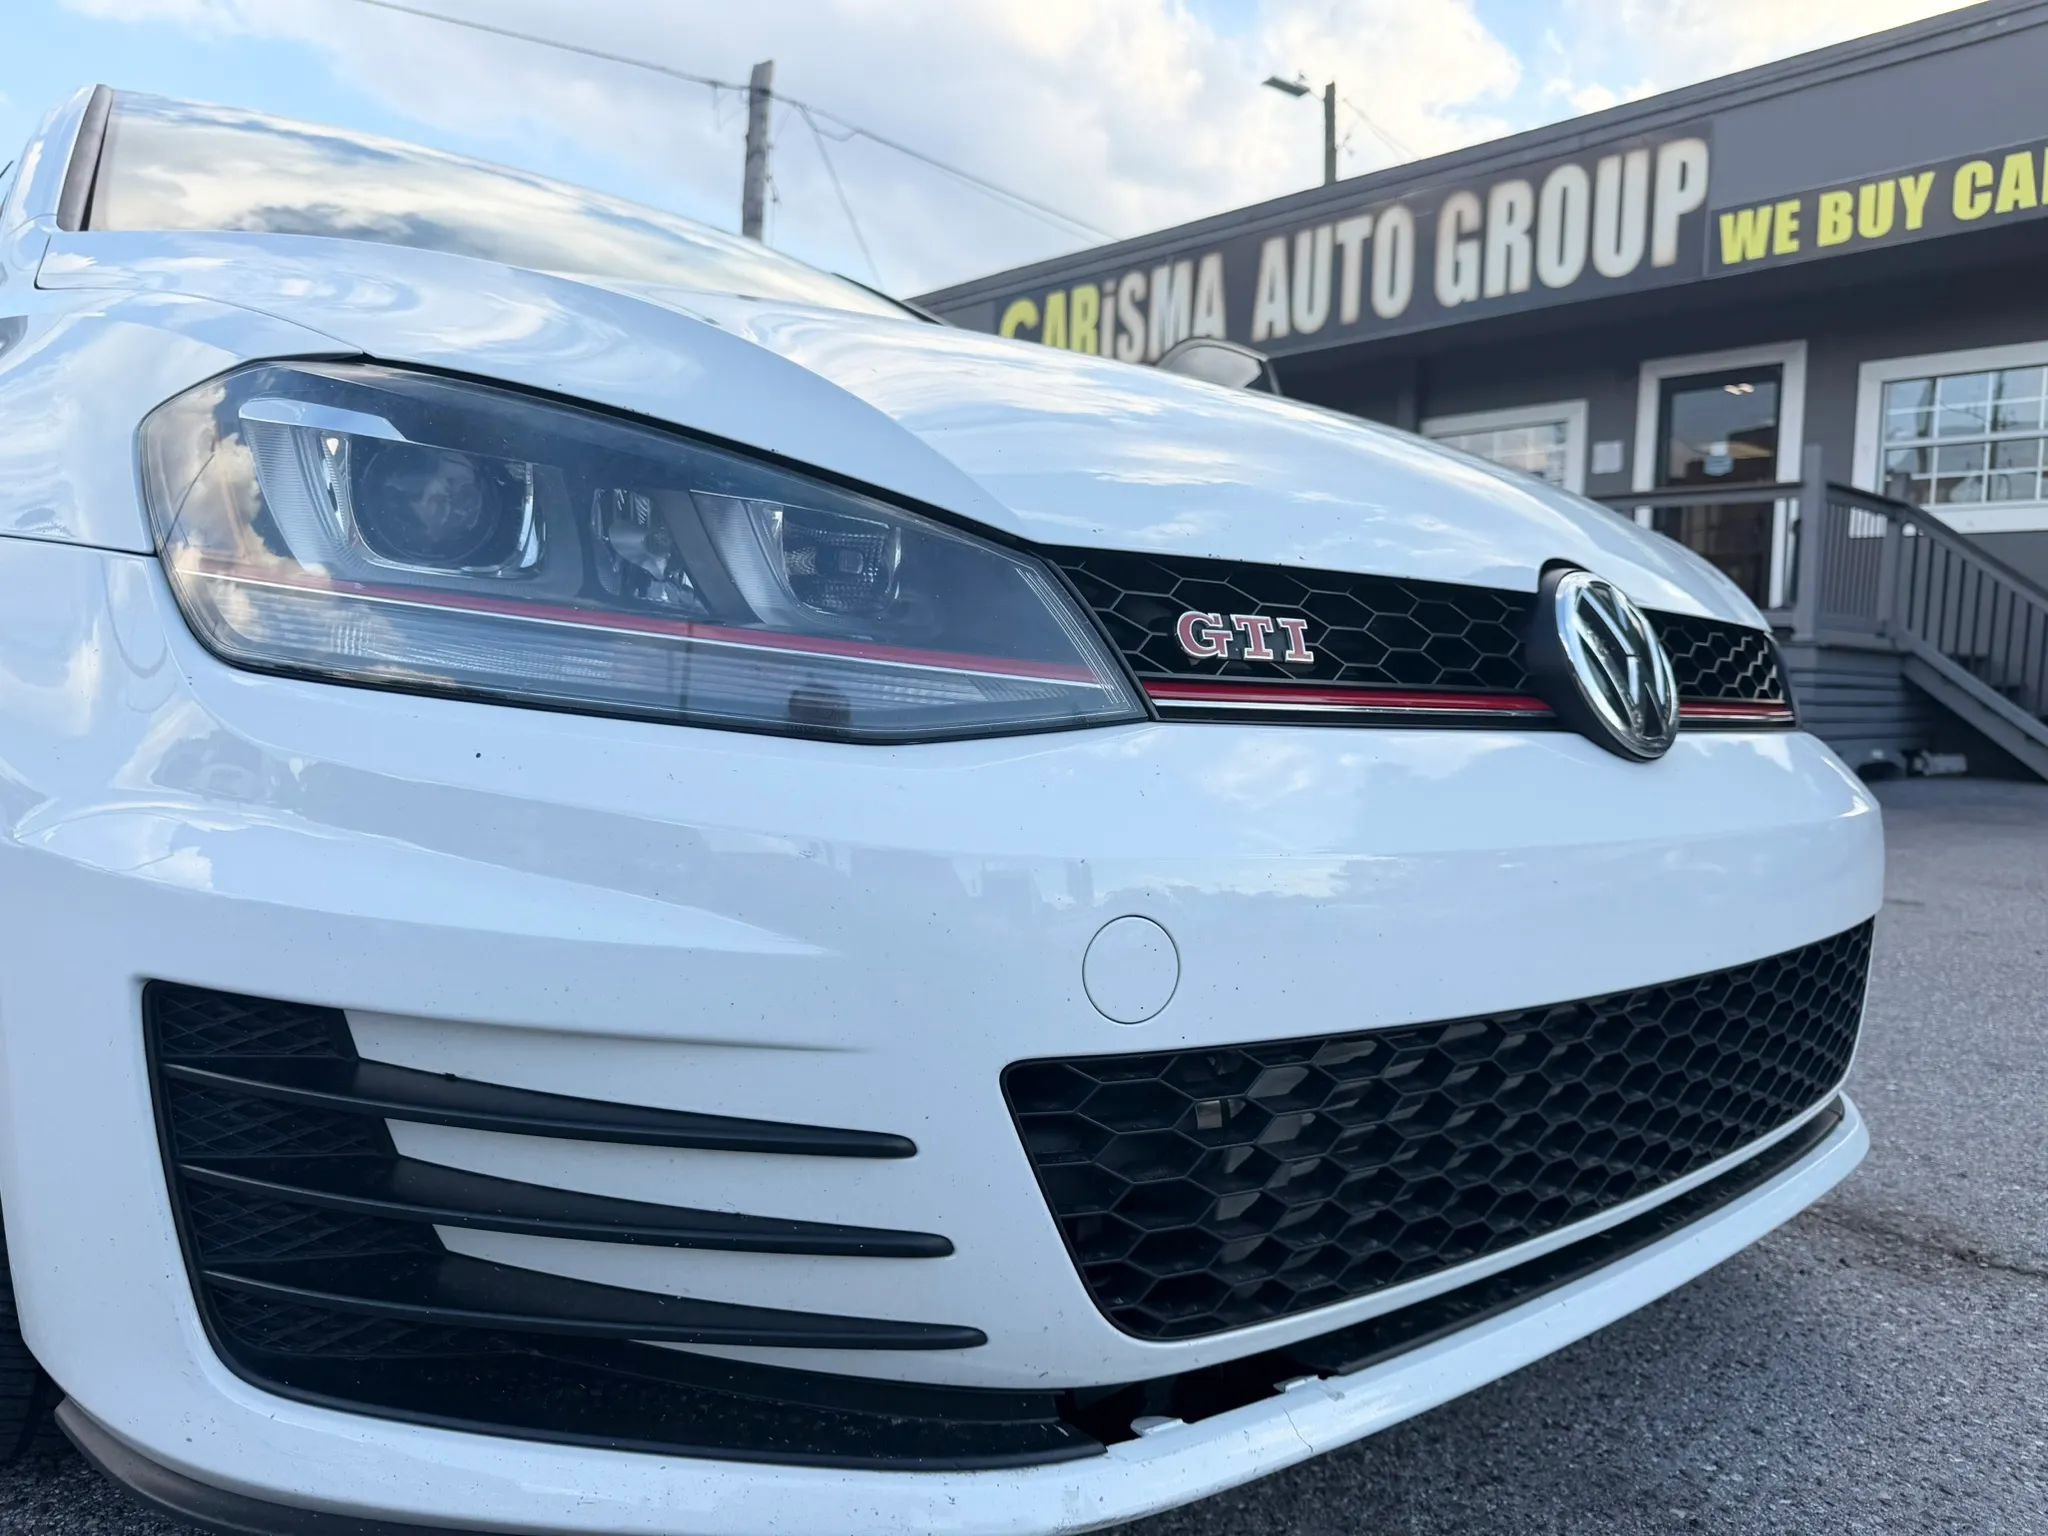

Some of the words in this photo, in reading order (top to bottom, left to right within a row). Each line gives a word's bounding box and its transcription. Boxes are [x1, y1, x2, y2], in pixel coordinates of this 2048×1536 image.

[1252, 205, 1416, 342] AUTO
[1435, 137, 1710, 308] GROUP
[1719, 199, 1800, 265] WE
[1817, 171, 1936, 248] BUY
[1952, 146, 2048, 221] CA
[1176, 610, 1315, 665] GTI
